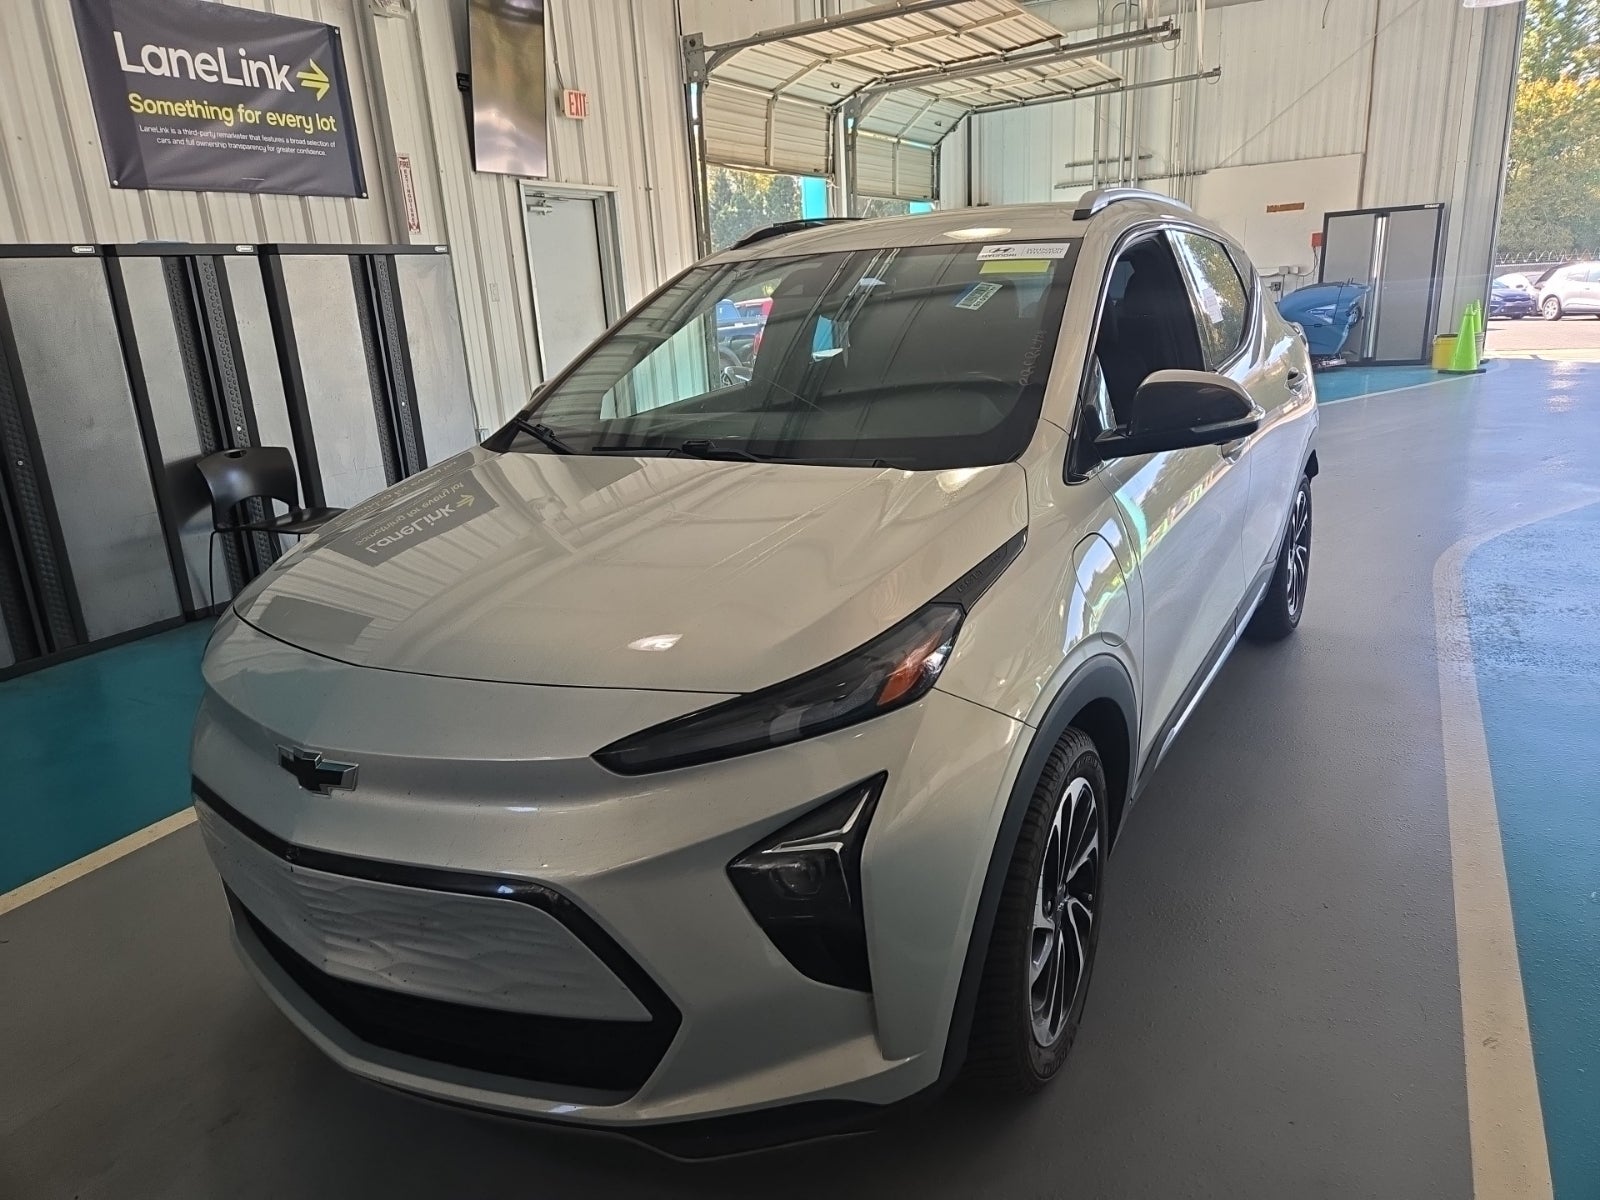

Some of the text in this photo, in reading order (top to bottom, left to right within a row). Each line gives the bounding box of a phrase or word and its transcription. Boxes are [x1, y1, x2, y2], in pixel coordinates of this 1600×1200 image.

[113, 30, 296, 93] LaneLink
[128, 92, 337, 134] Something for every lot
[568, 91, 586, 117] EXIT
[139, 124, 169, 134] LaneLink
[183, 128, 215, 139] third-party
[261, 134, 285, 143] features
[290, 137, 306, 145] broad
[307, 139, 329, 147] selection
[185, 137, 195, 146] full
[195, 141, 228, 149] ownership
[228, 142, 266, 153] transparency
